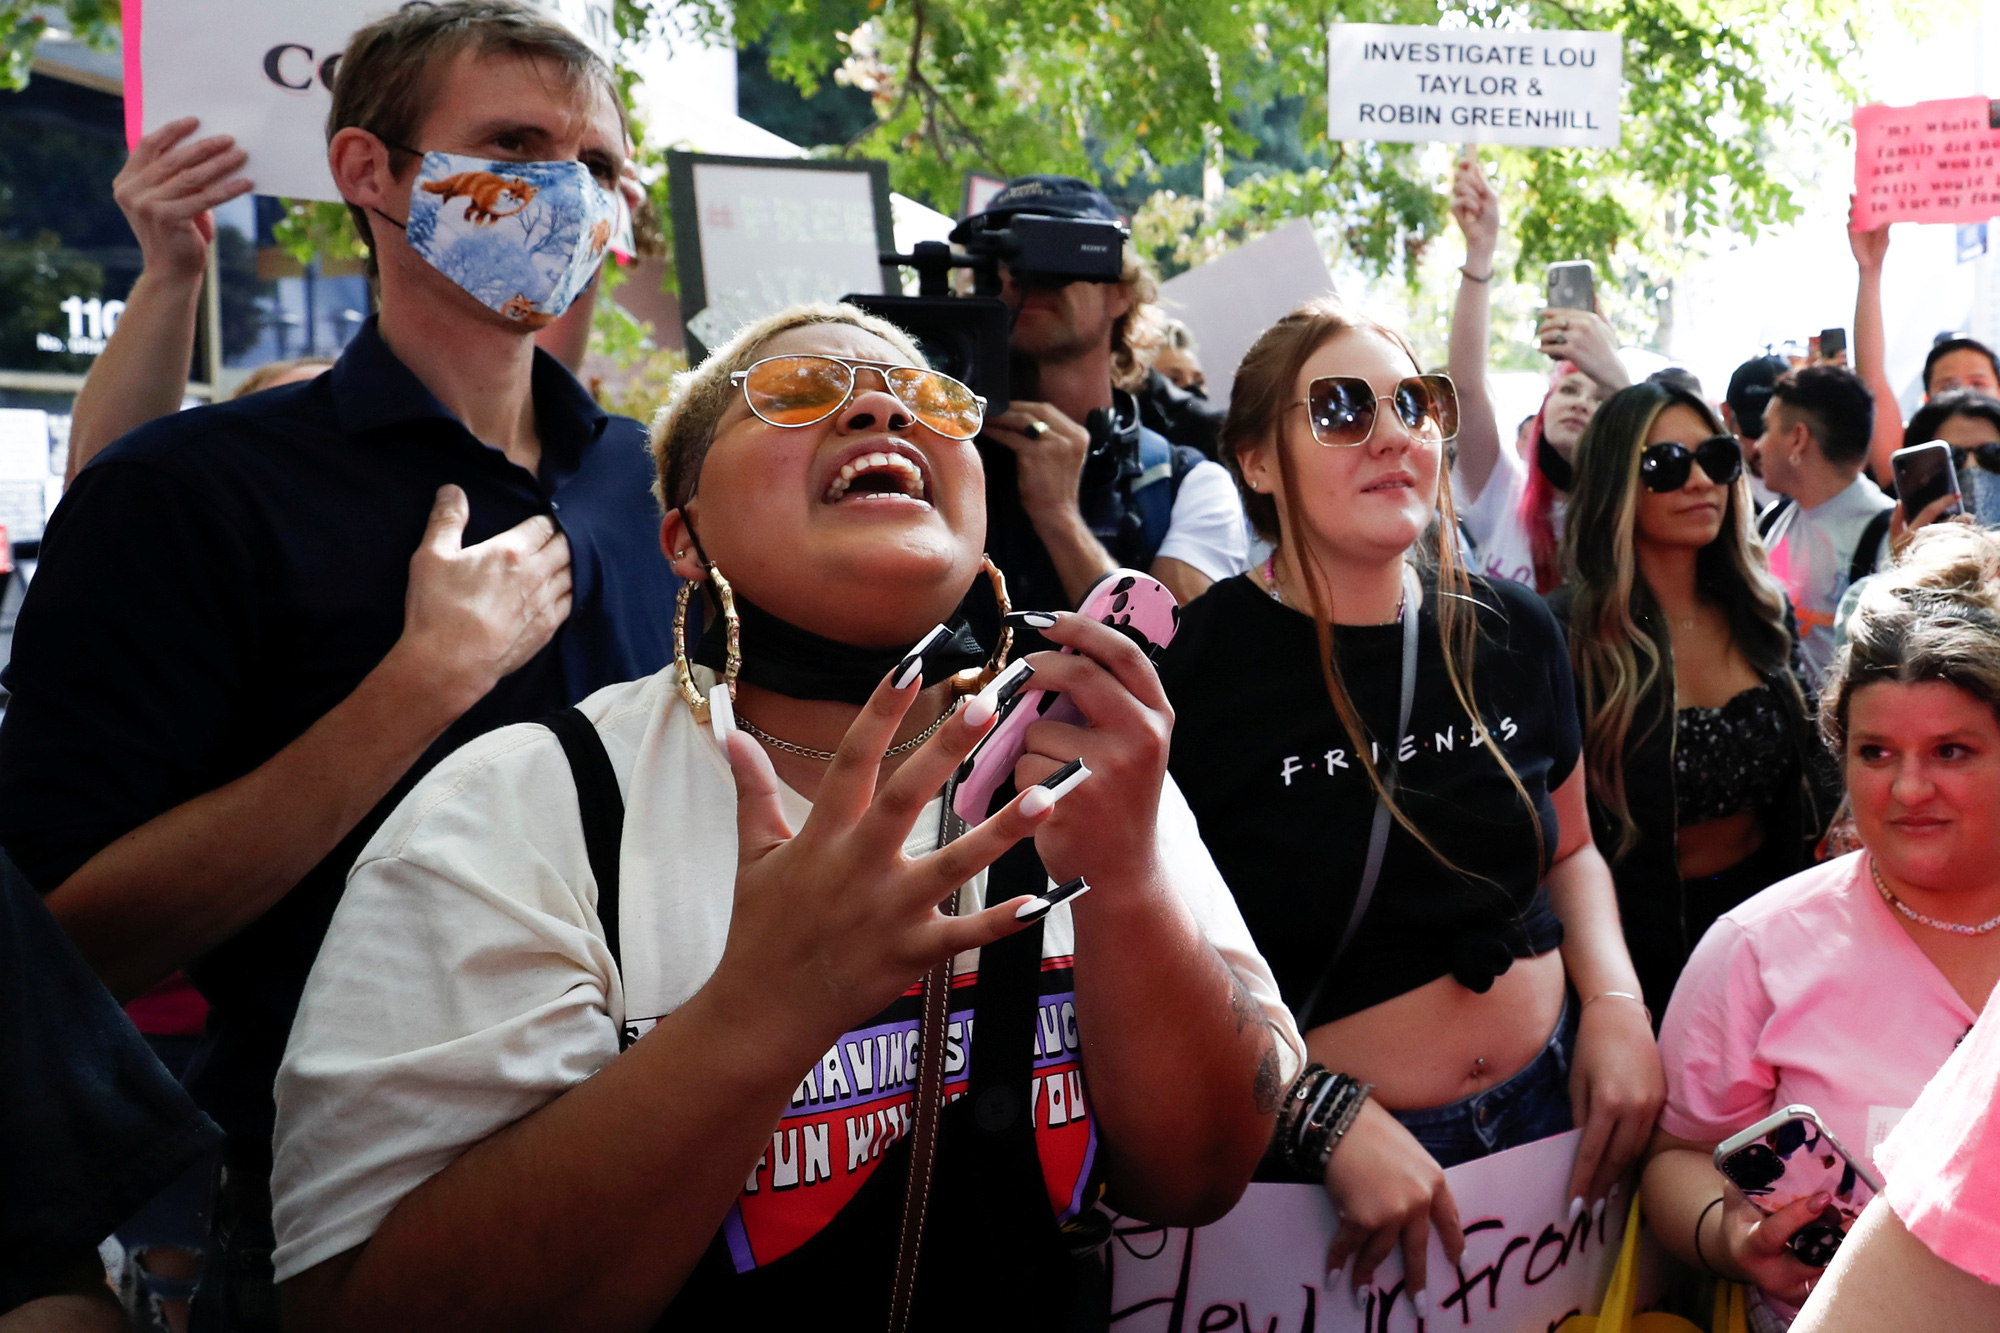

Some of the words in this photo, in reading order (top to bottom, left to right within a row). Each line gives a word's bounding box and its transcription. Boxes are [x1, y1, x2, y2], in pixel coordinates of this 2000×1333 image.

[1363, 42, 1533, 66] INVESTIGATE
[1544, 48, 1596, 67] LOU
[1417, 74, 1517, 95] TAYLOR
[1527, 78, 1543, 96] &
[1359, 103, 1441, 124] ROBIN
[1451, 106, 1599, 129] GREENHILL
[1877, 141, 1933, 158] family
[1080, 243, 1108, 253] SONY
